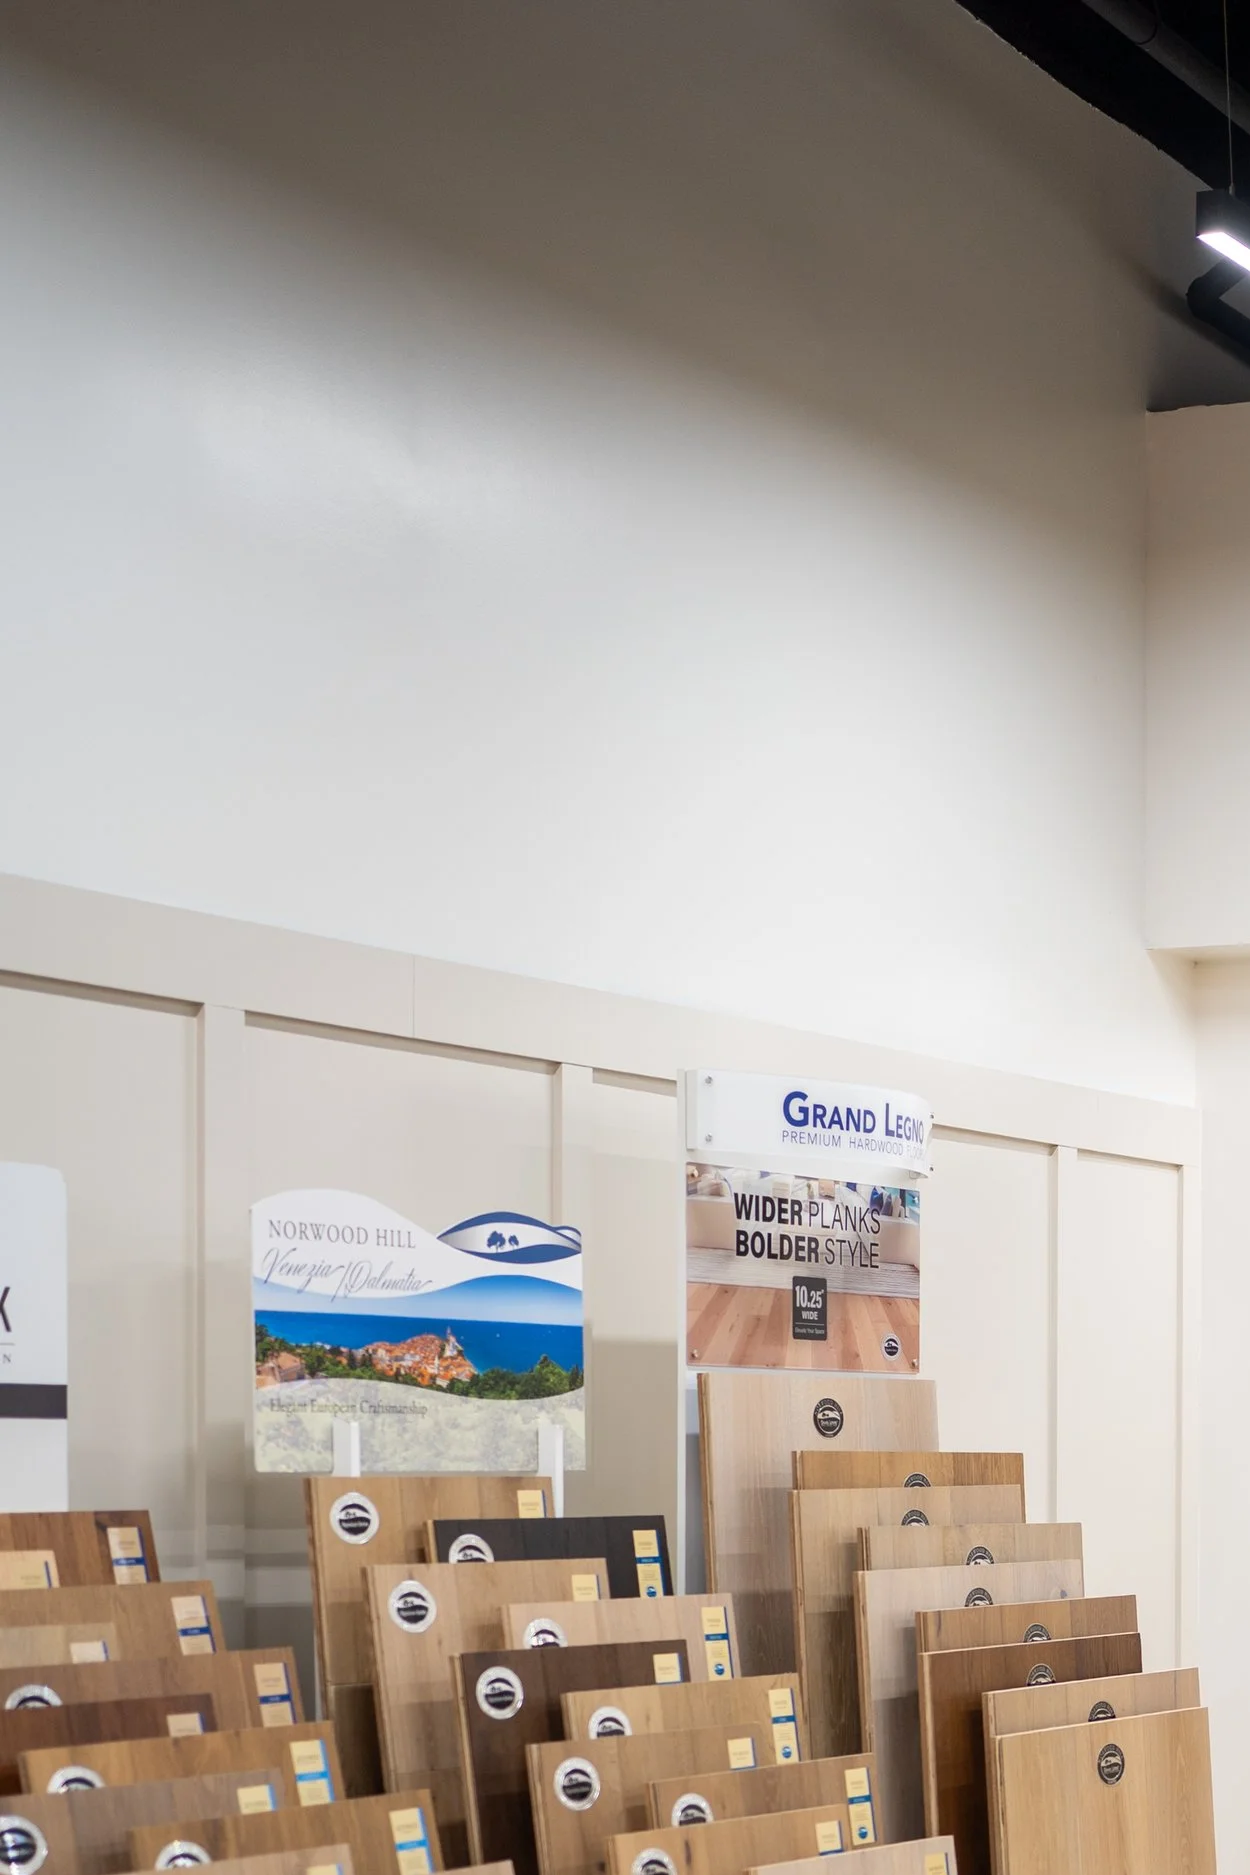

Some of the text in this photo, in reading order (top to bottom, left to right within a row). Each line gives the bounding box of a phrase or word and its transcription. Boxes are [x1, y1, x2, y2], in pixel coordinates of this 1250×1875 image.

[783, 1090, 925, 1145] GRAND LEGNO
[781, 1129, 842, 1148] PREMIUM
[849, 1137, 904, 1156] HARDWOOD
[734, 1192, 881, 1234] WIDER PLANKS
[268, 1219, 417, 1249] NORWOOD HILL
[735, 1229, 880, 1269] BOLDER STYLE
[802, 1310, 819, 1320] WIDE
[270, 1398, 307, 1417] Elegant
